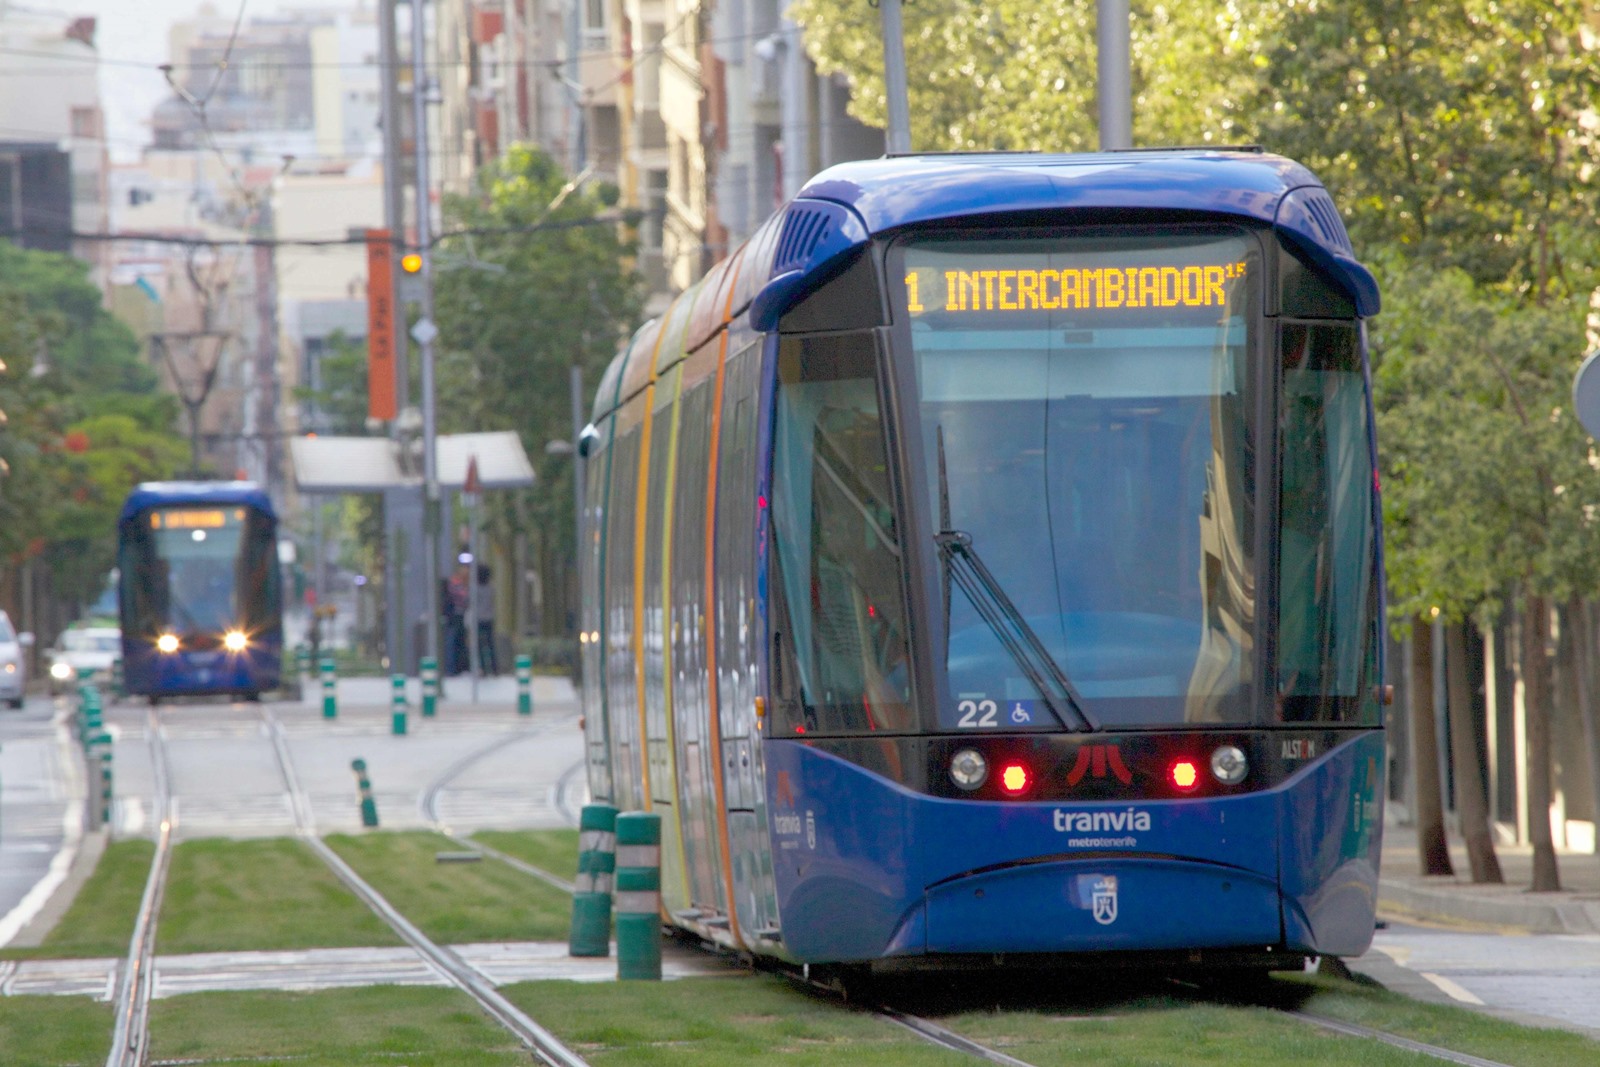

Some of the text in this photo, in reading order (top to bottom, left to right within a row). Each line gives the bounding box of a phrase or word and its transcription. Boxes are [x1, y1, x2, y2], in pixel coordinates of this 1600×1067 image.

[904, 271, 924, 312] 1
[945, 265, 1225, 311] INTERCAMBIADOR
[957, 699, 998, 728] 22
[1281, 738, 1315, 760] ALSTOM
[1053, 806, 1151, 832] tranvía
[1068, 836, 1137, 848] metrotenerife
